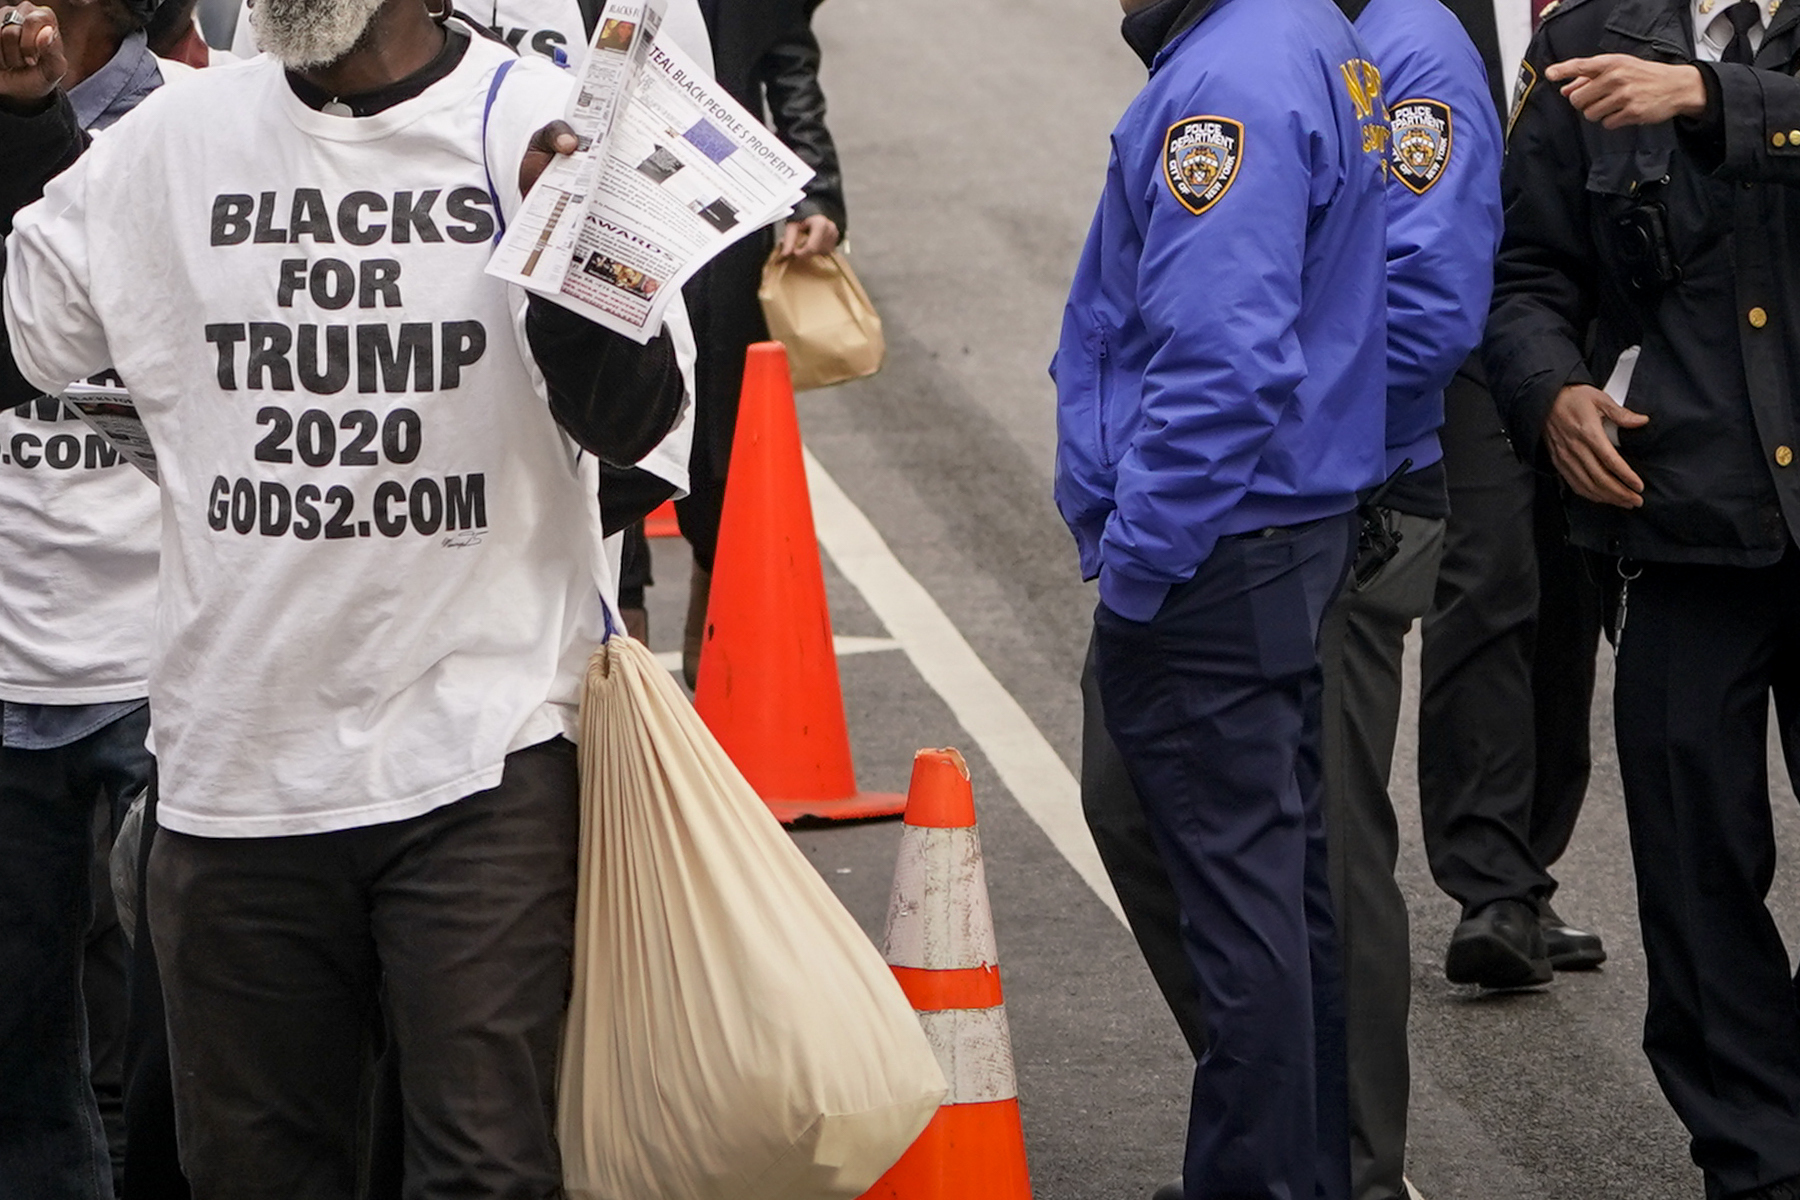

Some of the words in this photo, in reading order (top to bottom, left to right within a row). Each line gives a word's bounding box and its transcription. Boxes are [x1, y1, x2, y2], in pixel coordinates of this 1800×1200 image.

[647, 42, 673, 74] TEAL
[672, 70, 707, 104] BLACK
[702, 97, 751, 142] PEOPLE'S
[745, 134, 799, 182] PROPERTY
[1184, 122, 1222, 136] POLICE
[1390, 115, 1446, 132] EPARTMENT
[1394, 105, 1432, 119] POLICE
[1170, 132, 1235, 154] DEPARTMENT
[1399, 163, 1413, 176] OF
[1425, 163, 1441, 181] NEW
[1435, 136, 1448, 162] YORK
[1168, 159, 1182, 181] CITY
[1177, 182, 1191, 196] OF
[1204, 181, 1223, 201] NEW
[1218, 155, 1236, 181] YORK
[209, 186, 496, 247] BLACKS
[586, 213, 676, 263] AWARDS
[277, 257, 403, 311] FOR
[205, 319, 487, 396] TRUMP
[254, 406, 423, 467] 2020
[207, 472, 488, 541] GODS2.COM
